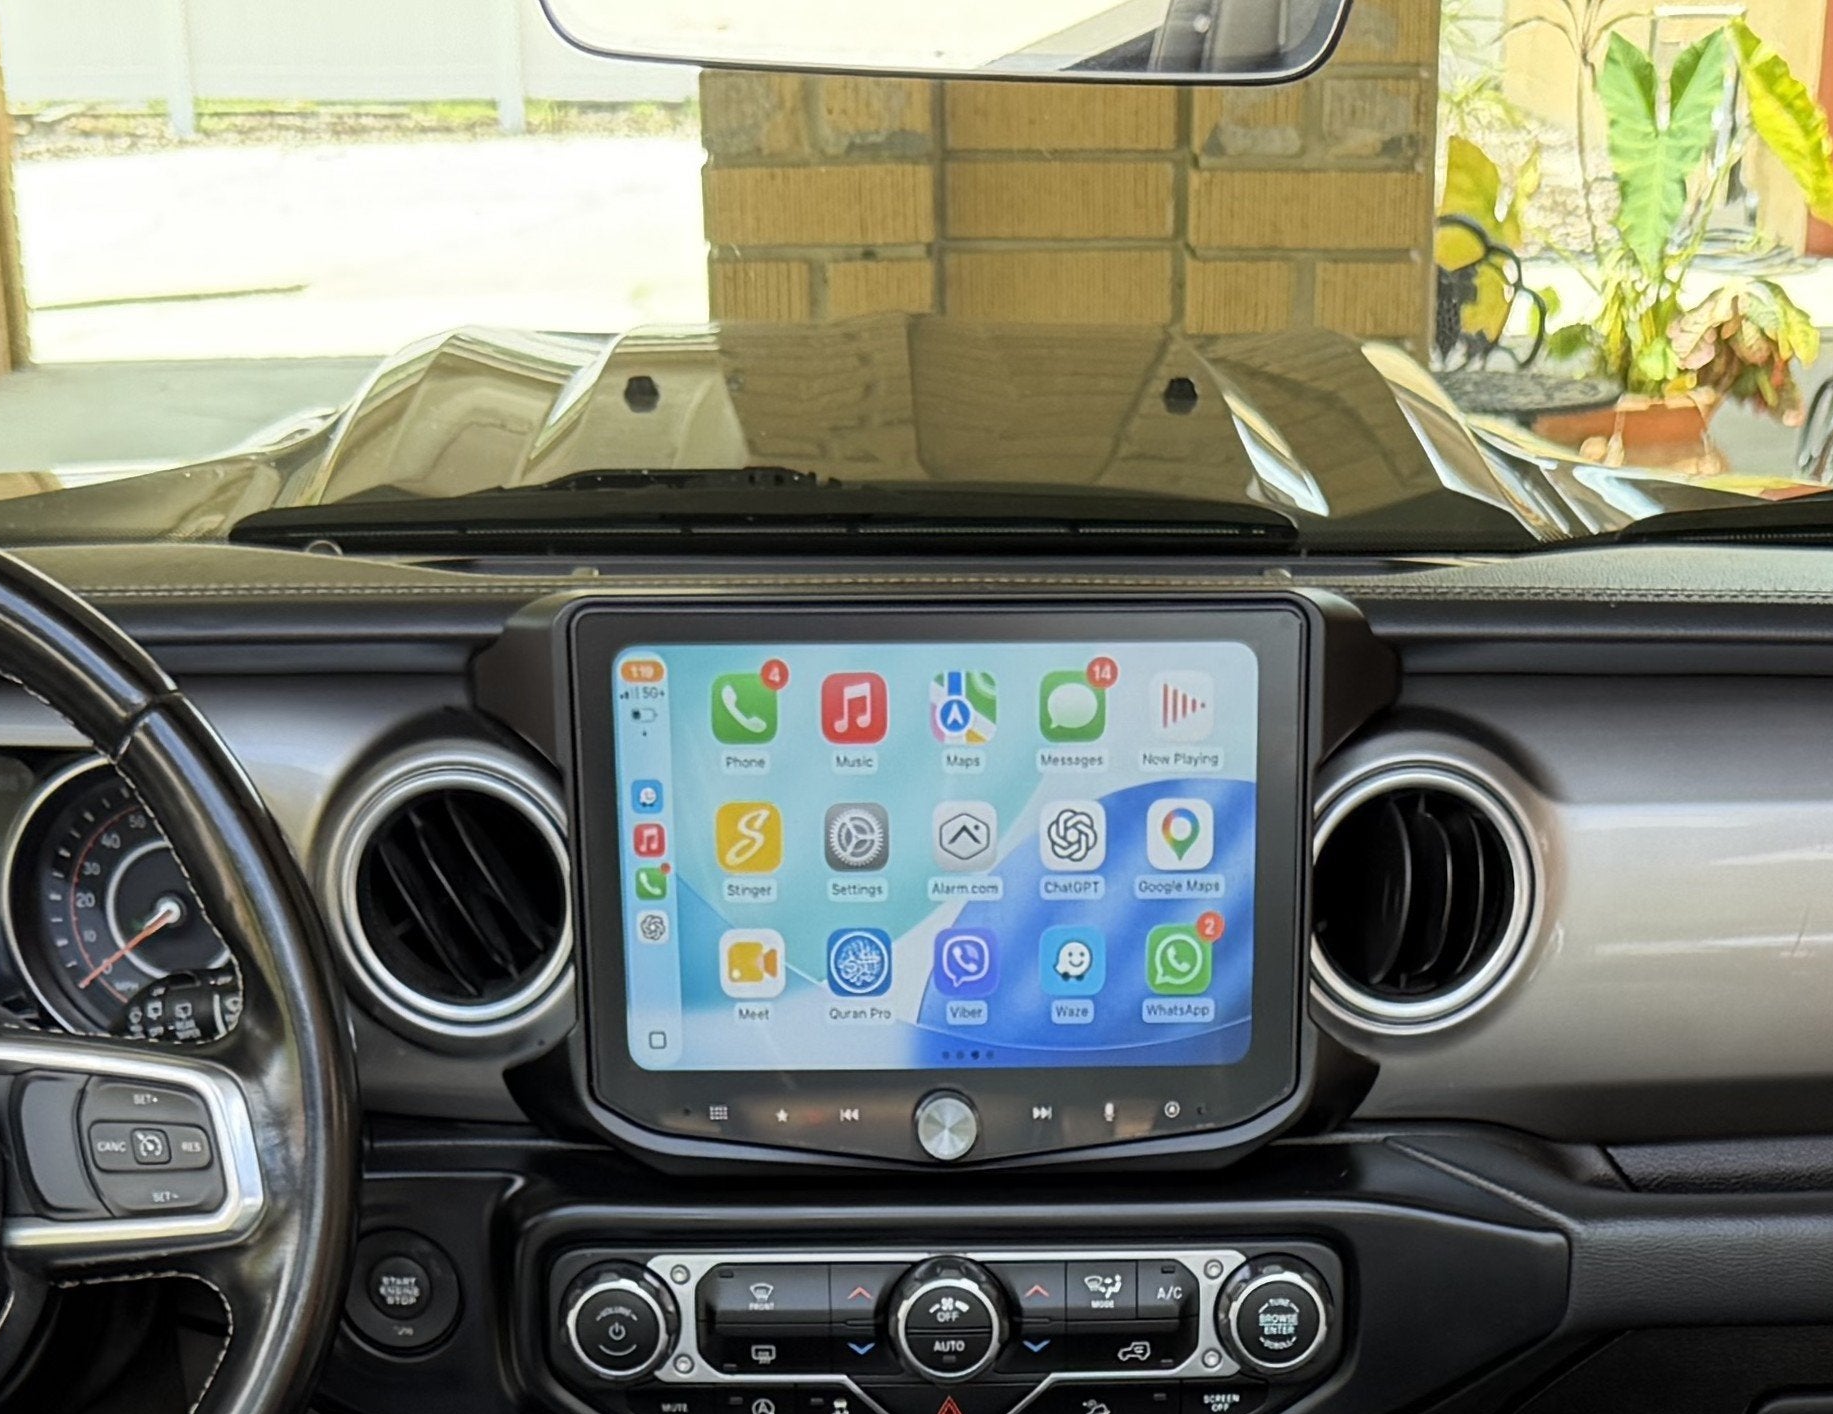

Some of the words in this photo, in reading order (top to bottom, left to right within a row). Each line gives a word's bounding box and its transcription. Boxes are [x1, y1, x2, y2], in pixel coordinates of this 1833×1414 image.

[769, 665, 781, 683] 4
[1093, 665, 1111, 680] 14
[725, 755, 766, 769] Phone
[835, 755, 874, 769] Music
[945, 753, 981, 770] Maps
[1040, 753, 1104, 769] Messages
[1141, 752, 1170, 766] Now
[1173, 752, 1219, 768] Playing
[101, 833, 121, 849] 40
[83, 862, 101, 876] 30
[726, 883, 773, 898] Stinger
[831, 883, 884, 897] Settings
[931, 882, 999, 895] Alarm.com
[1043, 881, 1101, 895] ChatGPT
[1138, 879, 1183, 895] Google
[1186, 879, 1220, 894] Maps
[76, 893, 96, 908] 20
[1204, 918, 1215, 935] 2
[738, 1008, 770, 1020] Meet
[829, 1008, 868, 1020] Quran
[870, 1008, 892, 1020] Pro
[949, 1005, 983, 1018] Viber
[1055, 1005, 1089, 1018] Waze
[1146, 1004, 1210, 1017] WhatsApp
[96, 1141, 127, 1153] CANC
[180, 1141, 202, 1153] RES
[1156, 1287, 1183, 1300] A/C
[936, 1311, 959, 1323] OFF
[933, 1340, 966, 1352] AUTO
[1203, 1394, 1241, 1404] SCREEN
[661, 1402, 689, 1413] MUTE
[1211, 1403, 1230, 1413] OFF
